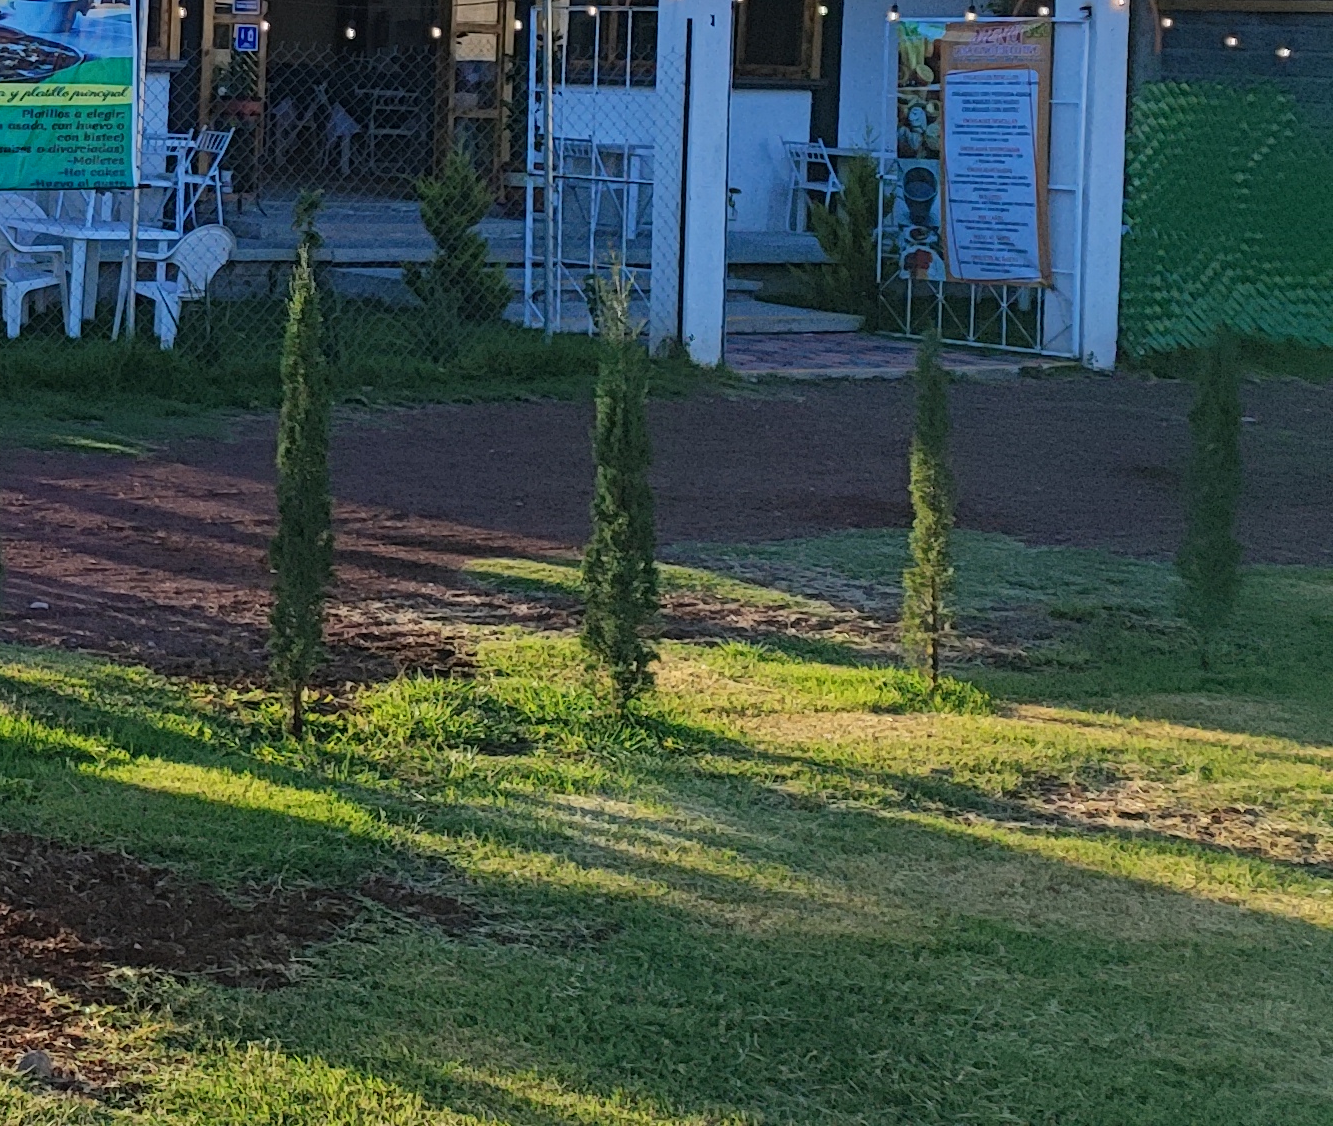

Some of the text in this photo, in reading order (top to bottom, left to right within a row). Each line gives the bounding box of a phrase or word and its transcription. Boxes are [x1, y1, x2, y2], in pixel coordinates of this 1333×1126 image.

[7, 89, 19, 103] y
[22, 109, 71, 119] Platillos
[74, 111, 82, 119] a
[56, 134, 79, 142] con
